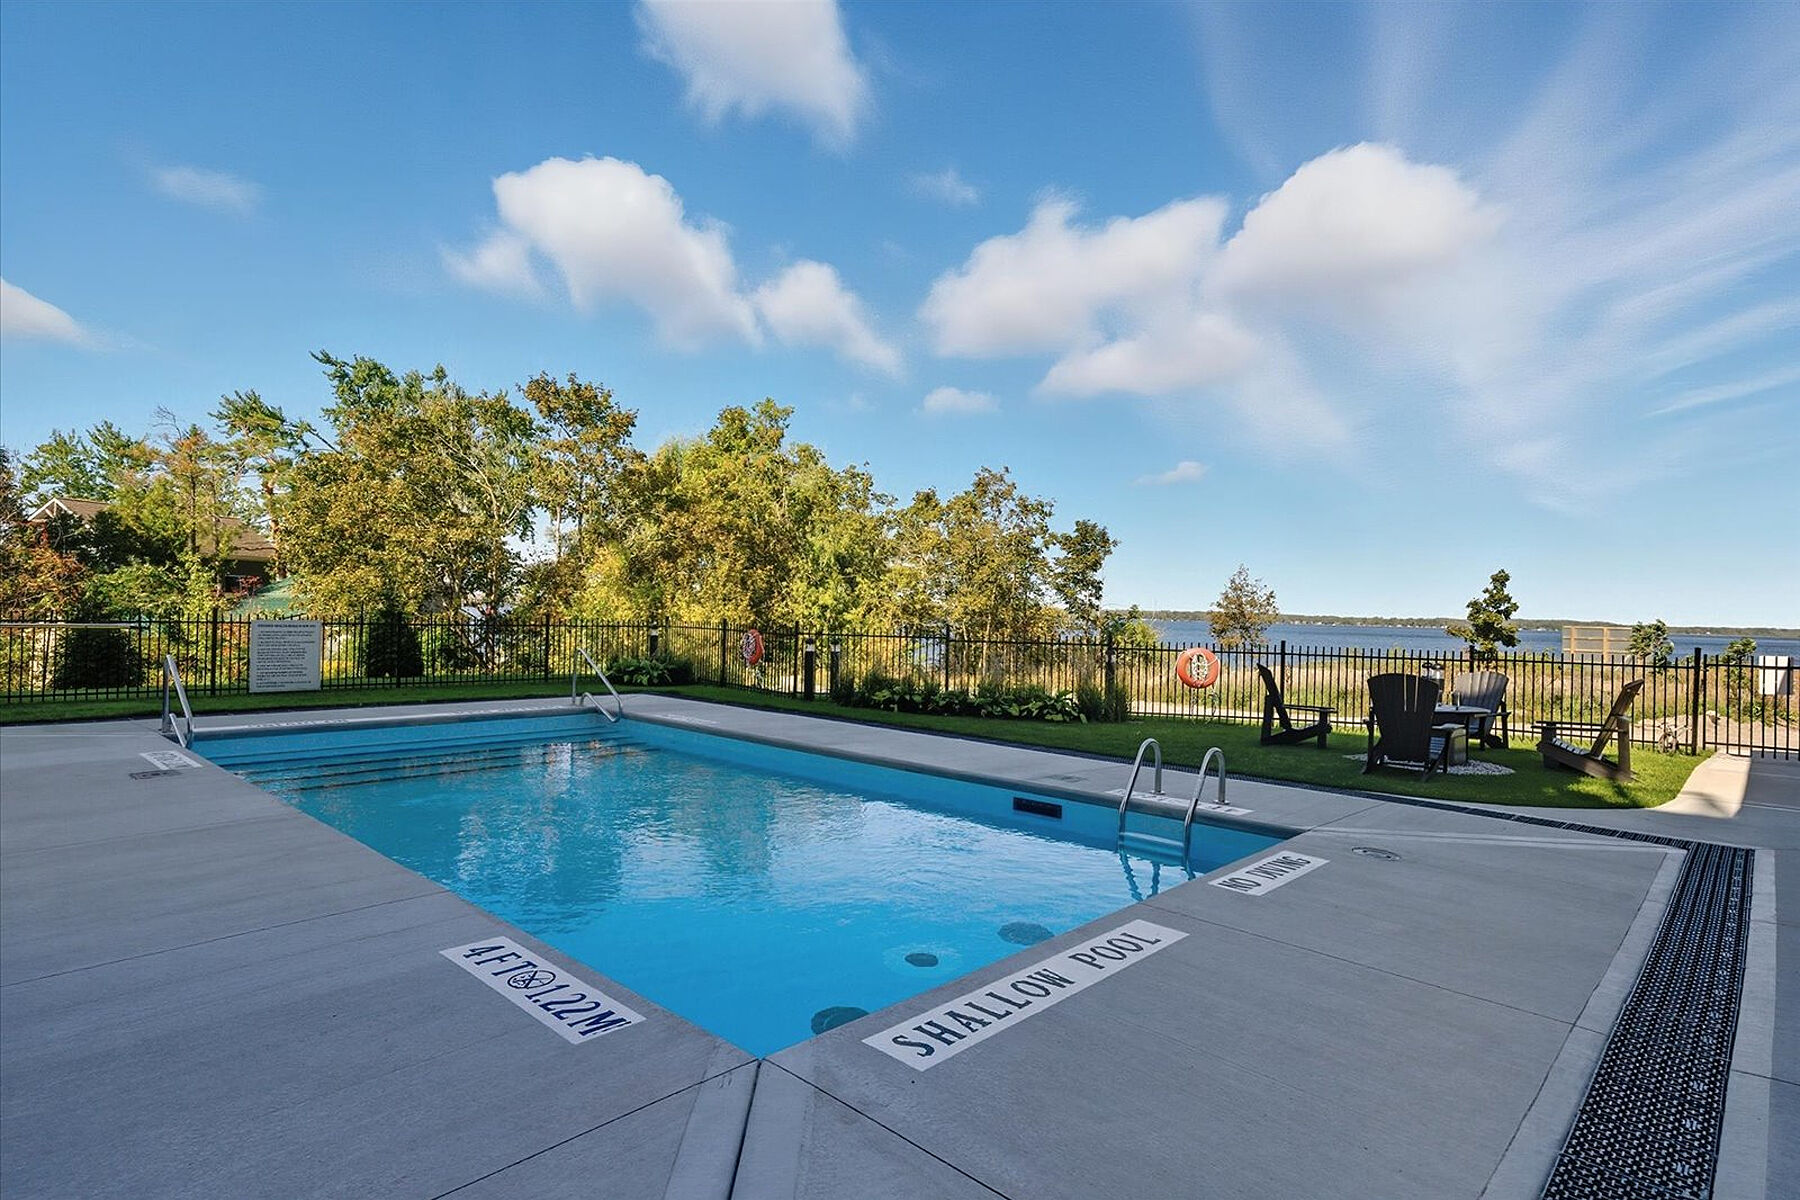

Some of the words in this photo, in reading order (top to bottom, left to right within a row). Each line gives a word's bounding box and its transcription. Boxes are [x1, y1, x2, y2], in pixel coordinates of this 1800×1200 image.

[1218, 877, 1262, 892] NO
[1246, 855, 1312, 880] DIVING
[525, 983, 631, 1037] 1.22M
[892, 968, 1076, 1057] SHALLOW
[1068, 931, 1162, 969] POOL
